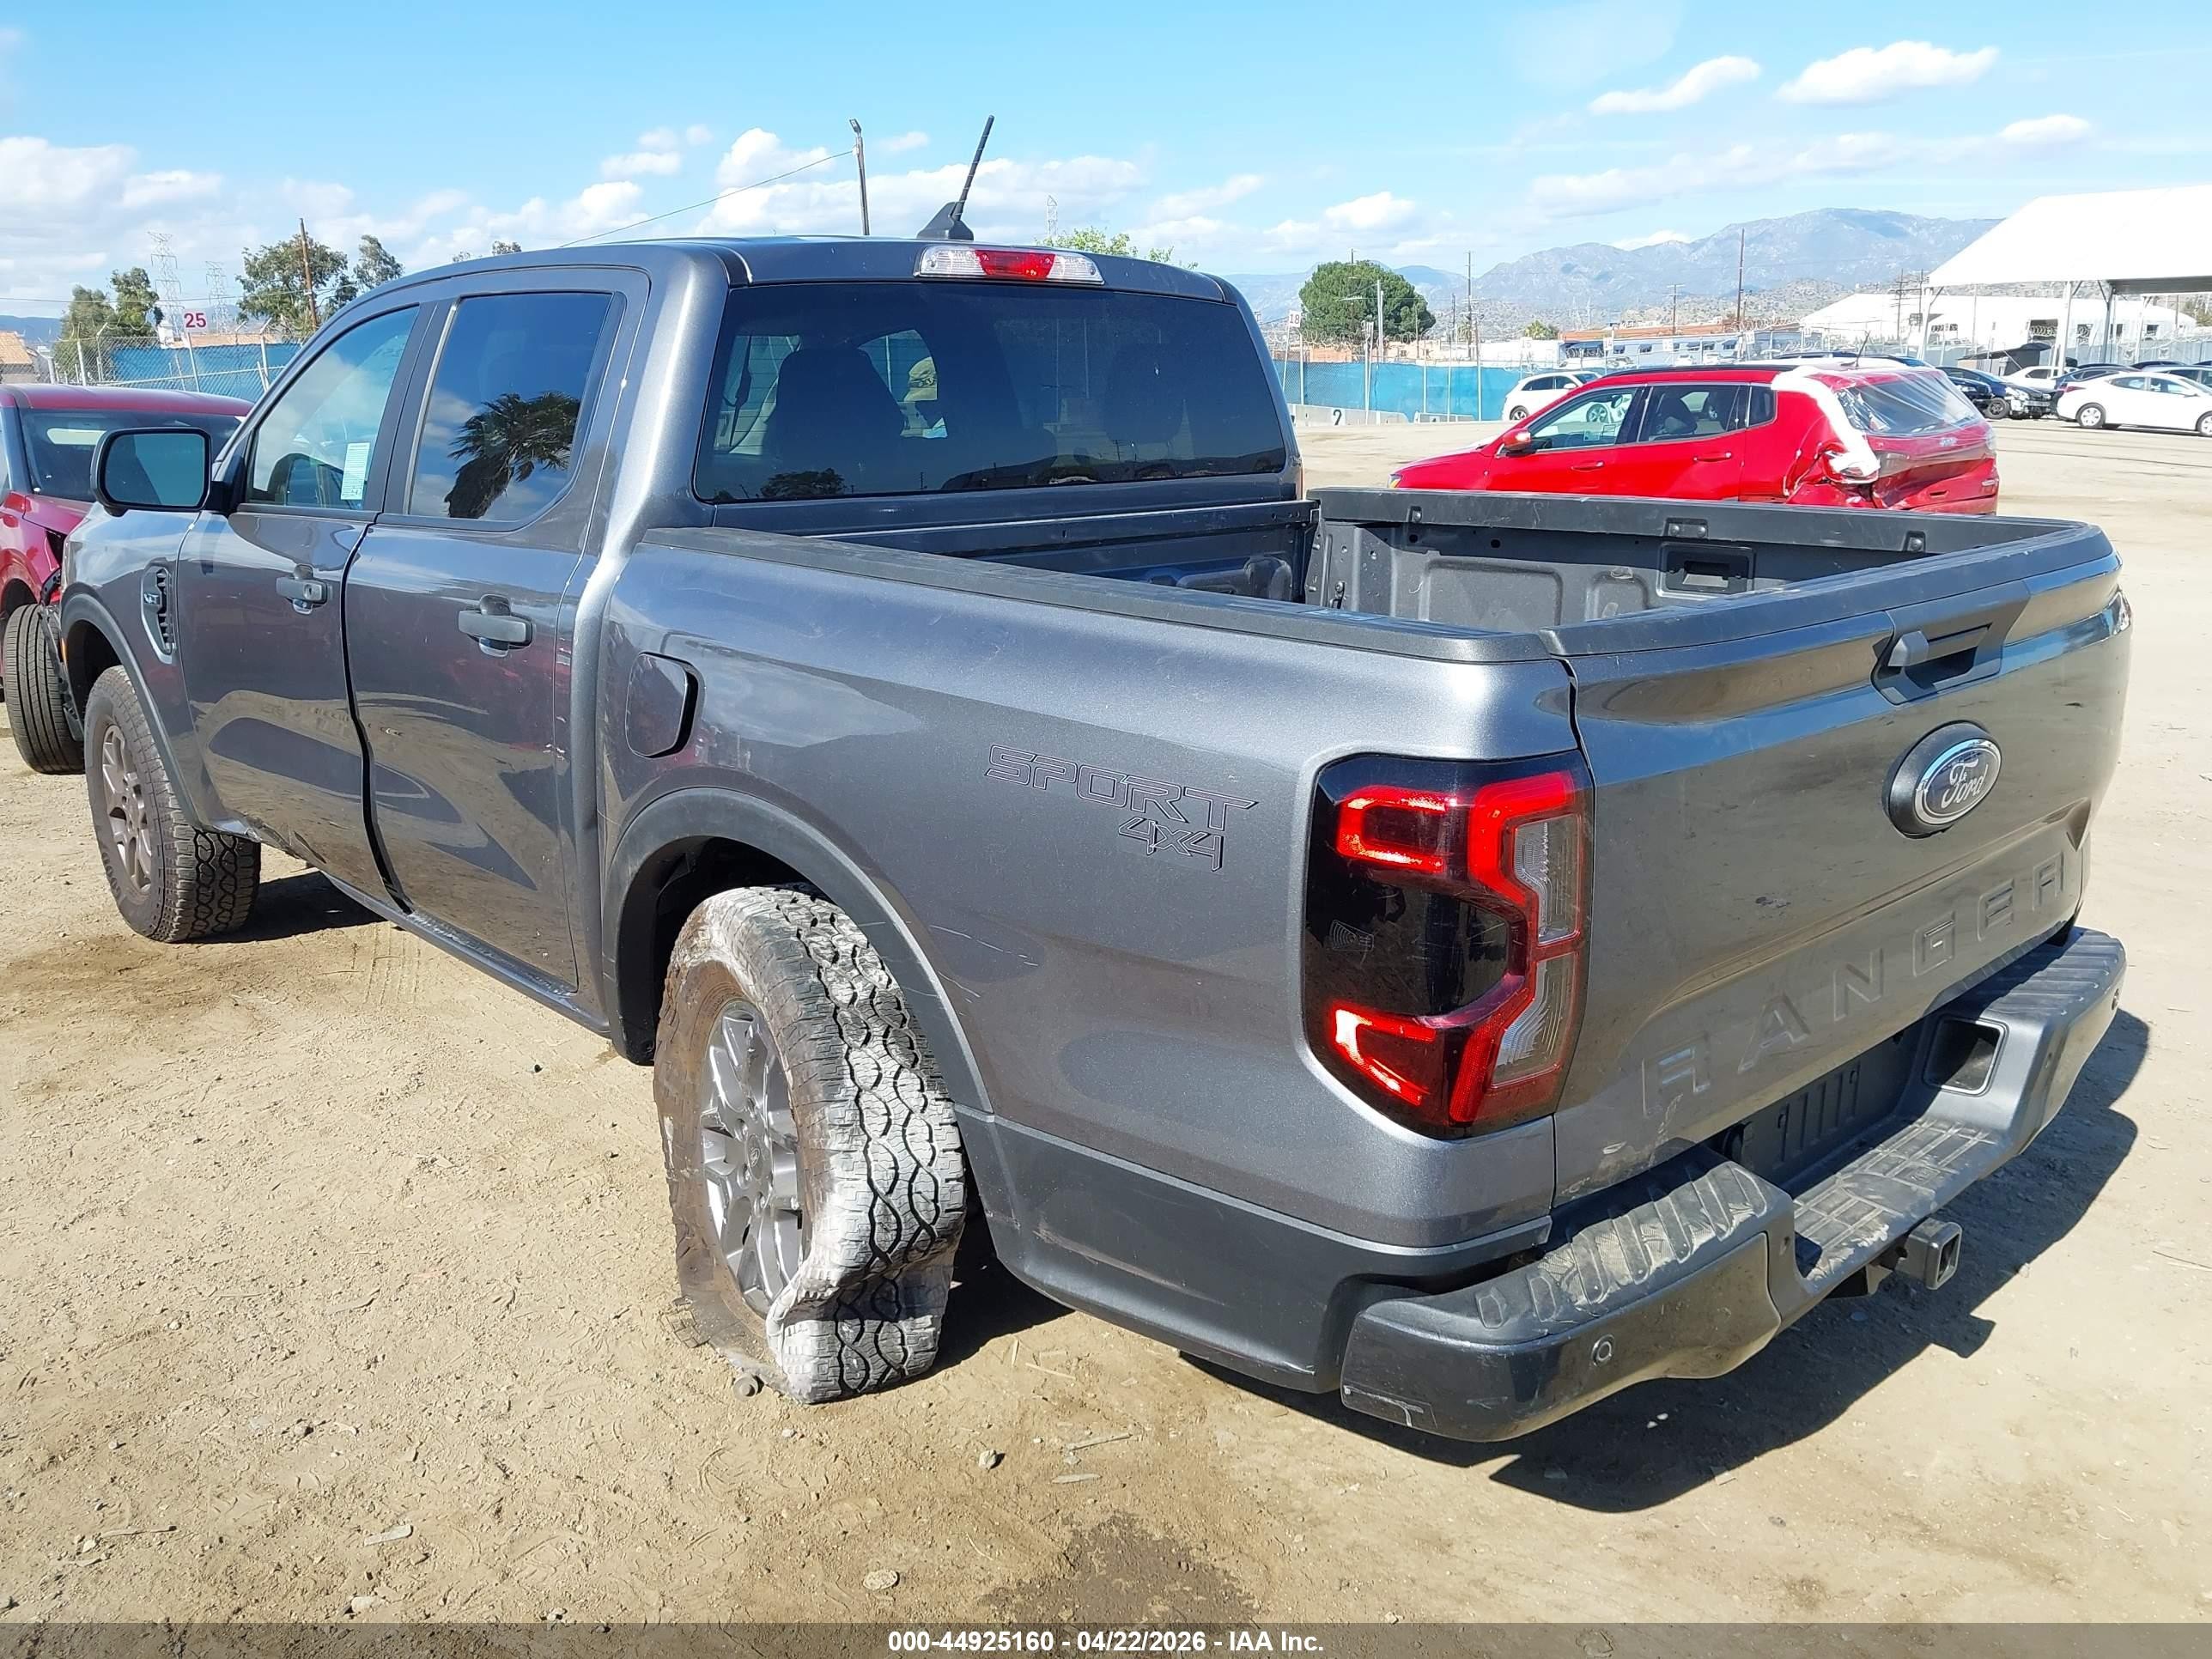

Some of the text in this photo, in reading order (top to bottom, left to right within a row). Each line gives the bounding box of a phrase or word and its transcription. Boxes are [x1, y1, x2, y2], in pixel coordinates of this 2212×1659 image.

[183, 312, 207, 328] 25
[1289, 313, 1301, 325] 18
[985, 744, 1259, 832] SPORT
[1941, 758, 1990, 809] Ford
[1641, 851, 2066, 1117] RANGER
